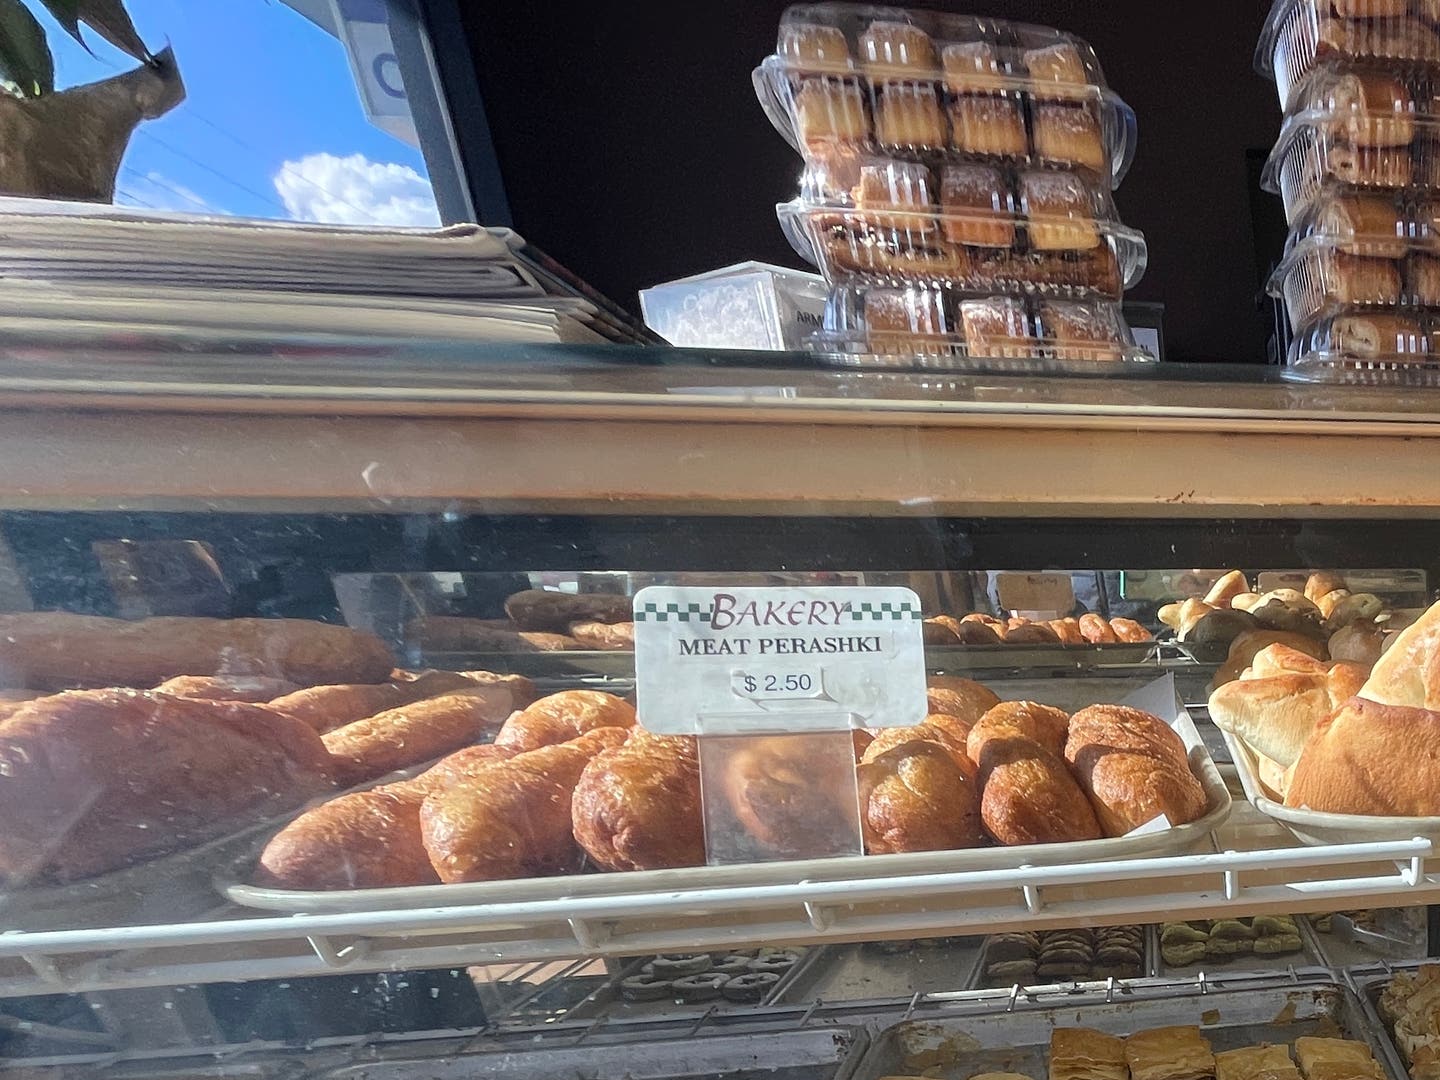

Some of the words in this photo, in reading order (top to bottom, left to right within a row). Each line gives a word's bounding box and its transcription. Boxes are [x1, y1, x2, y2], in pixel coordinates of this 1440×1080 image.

[711, 593, 850, 630] BAKERY
[679, 638, 751, 656] MEAT
[759, 636, 882, 654] PERASHKI
[765, 674, 812, 692] 2.50
